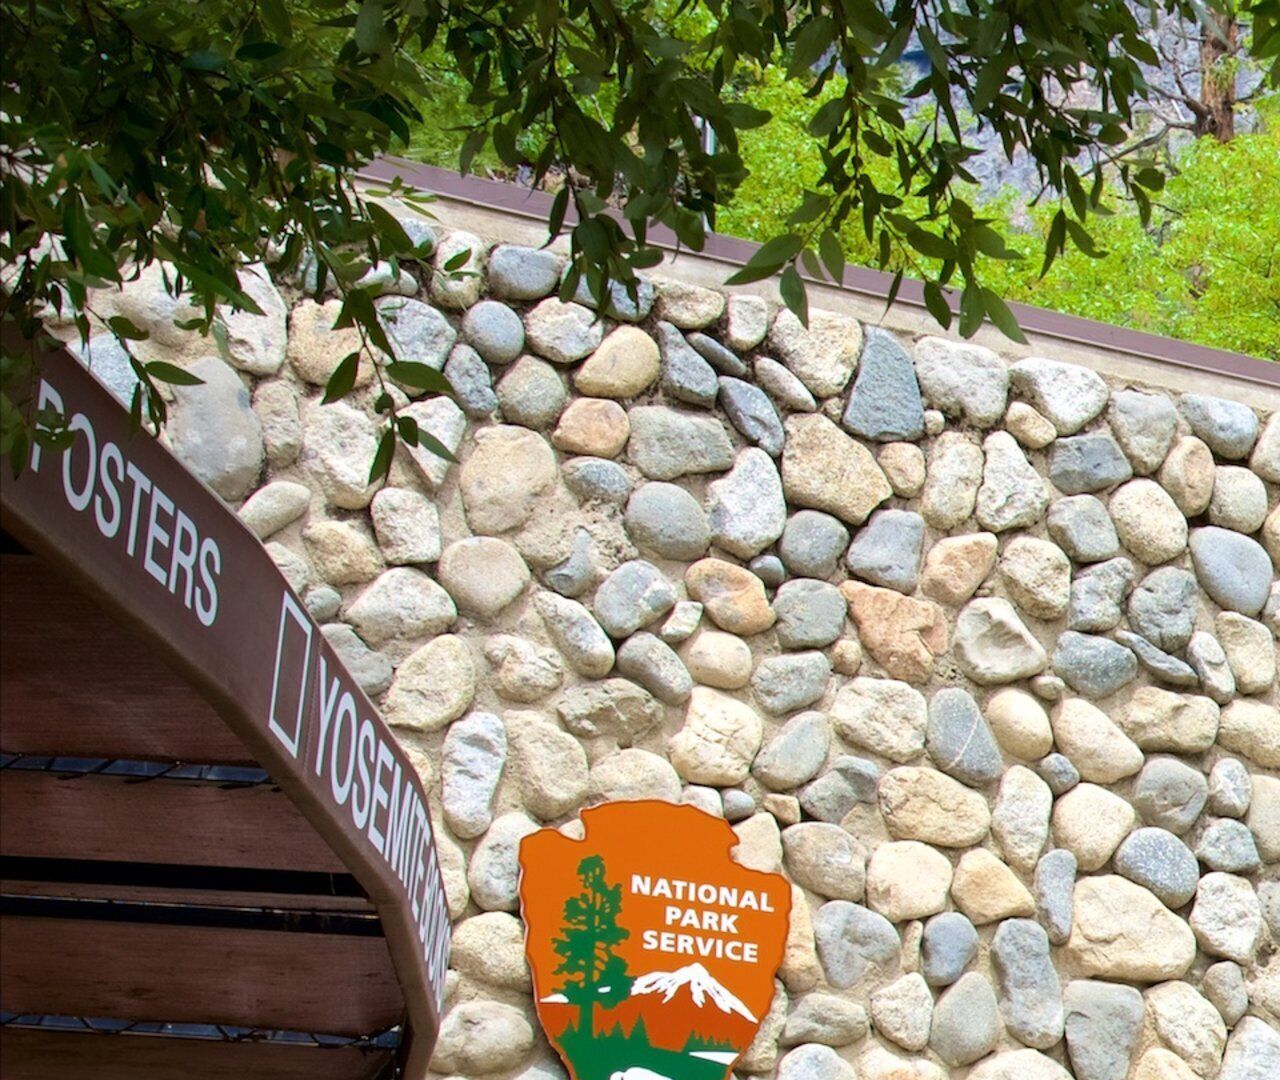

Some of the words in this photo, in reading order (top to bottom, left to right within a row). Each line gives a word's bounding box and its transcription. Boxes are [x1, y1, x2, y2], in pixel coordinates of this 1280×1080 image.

[31, 378, 222, 627] POSTERS
[316, 655, 430, 922] YOSEMITE
[631, 874, 775, 912] NATIONAL
[665, 906, 739, 934] PARK
[642, 930, 758, 963] SERVICE
